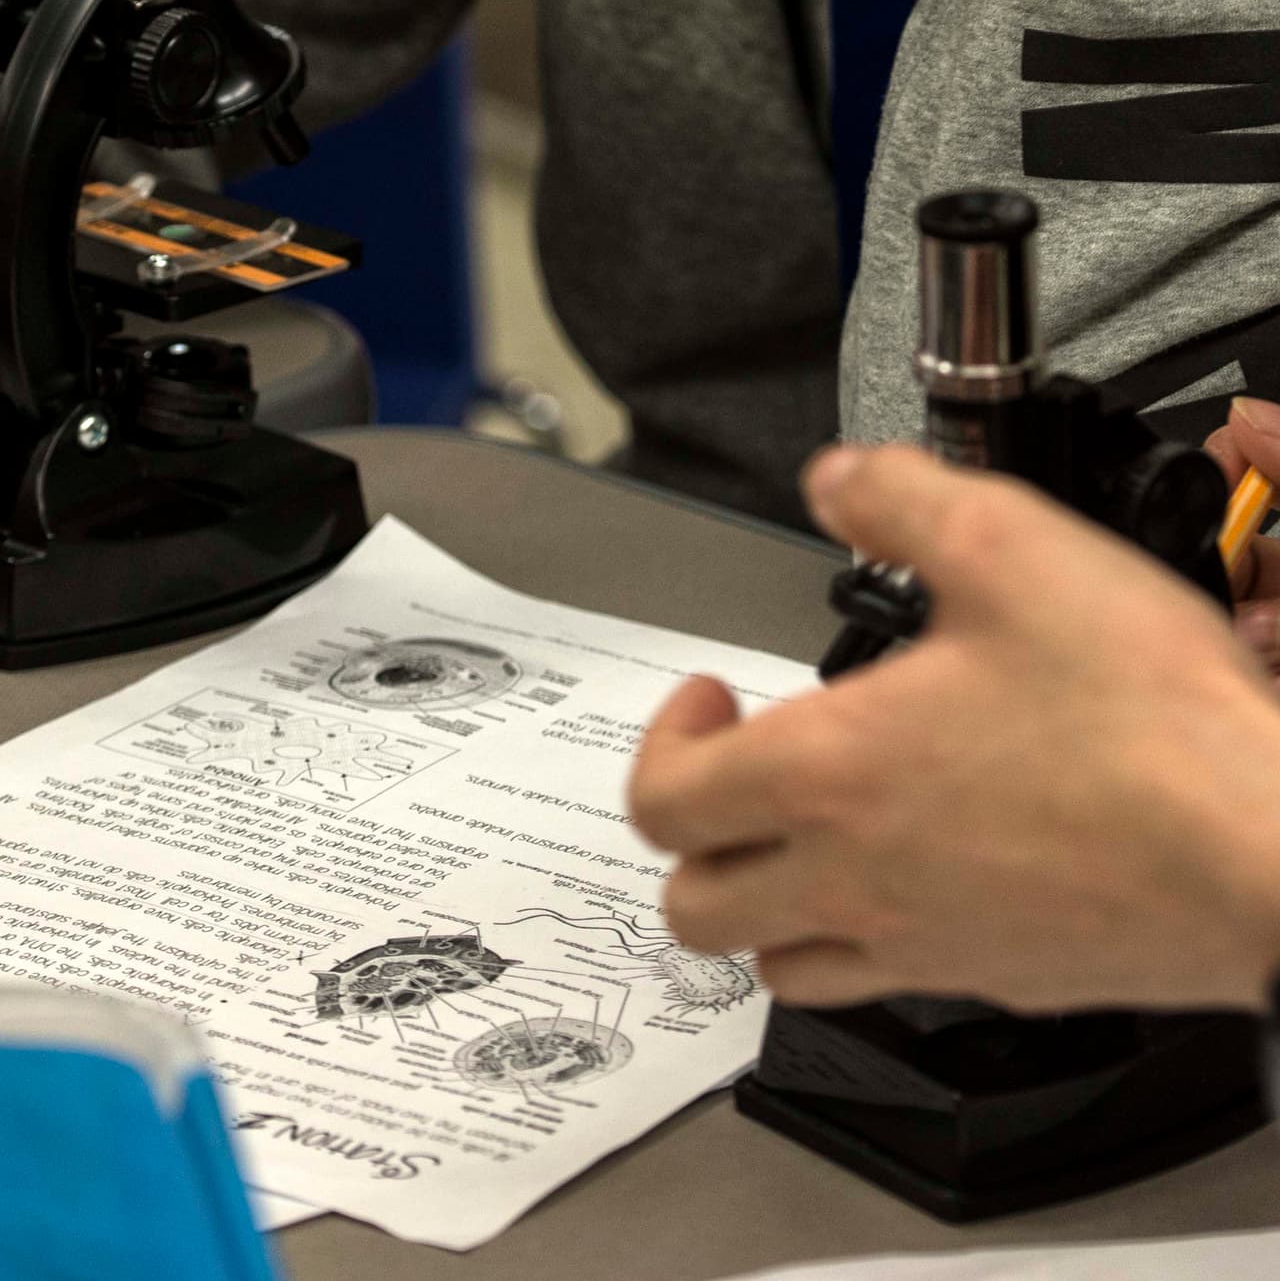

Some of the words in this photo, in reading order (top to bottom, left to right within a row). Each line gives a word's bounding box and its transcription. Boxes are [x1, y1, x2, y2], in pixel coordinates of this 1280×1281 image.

[204, 765, 269, 787] Amoeba
[35, 790, 95, 812] Bacteria
[147, 792, 186, 805] some
[244, 789, 270, 799] are
[522, 791, 570, 806] include
[119, 799, 139, 807] up
[183, 803, 214, 812] and
[212, 796, 289, 822] multicellular
[140, 804, 181, 818] make
[306, 804, 346, 820] many
[134, 814, 174, 830] single
[180, 814, 213, 826] cells
[215, 811, 261, 829] plants
[285, 815, 307, 824] All
[347, 817, 384, 832] have
[106, 821, 151, 839] called
[170, 825, 193, 835] of
[259, 823, 286, 832] are
[287, 830, 306, 838] as
[382, 827, 415, 841] that
[466, 819, 514, 841] include
[192, 833, 244, 853] consist
[213, 823, 286, 849] Eukaryotic
[151, 834, 222, 857] organisms
[240, 845, 272, 857] and
[418, 836, 489, 859] organisms
[510, 833, 591, 857] organisms)
[40, 851, 77, 864] have
[222, 855, 243, 863] up
[272, 853, 301, 866] tiny
[384, 839, 472, 869] single-celled
[19, 861, 46, 869] are
[74, 859, 103, 868] not
[103, 866, 123, 874] do
[244, 861, 285, 875] make
[303, 864, 330, 873] are
[326, 856, 411, 881] prokaryotic
[397, 860, 424, 870] are
[46, 863, 117, 887] organelles
[123, 871, 155, 882] cells
[285, 872, 318, 884] cells
[424, 868, 451, 880] You
[330, 871, 422, 898] prokaryotes
[409, 879, 436, 888] are
[552, 879, 577, 889] cells
[72, 887, 143, 910] organelles,
[115, 885, 156, 900] Most
[156, 880, 238, 909] Prokaryotic
[318, 882, 400, 911] Prokaryotic
[576, 881, 639, 905] prokaryotic
[260, 894, 283, 908] by
[636, 900, 655, 910] are
[0, 902, 72, 922] substance
[144, 908, 181, 924] have
[202, 911, 229, 922] for
[278, 901, 364, 930] surrounded
[4, 915, 88, 941] prokaryotic
[181, 919, 214, 932] cells
[231, 919, 269, 934] jobs
[85, 938, 101, 948] In
[122, 930, 148, 946] the
[263, 925, 331, 954] perform
[324, 930, 346, 942] by
[215, 931, 290, 960] Eukaryotic
[19, 953, 56, 968] have
[56, 947, 82, 960] the
[56, 963, 90, 976] cells
[88, 955, 122, 970] cells,
[265, 963, 290, 971] of
[164, 964, 190, 977] the
[192, 973, 208, 981] in
[227, 967, 254, 980] the
[28, 973, 66, 989] have
[122, 968, 197, 995] eukaryotic
[204, 976, 251, 994] found
[90, 974, 176, 1004] prokaryotic
[198, 991, 214, 1001] In
[174, 1001, 212, 1015] while
